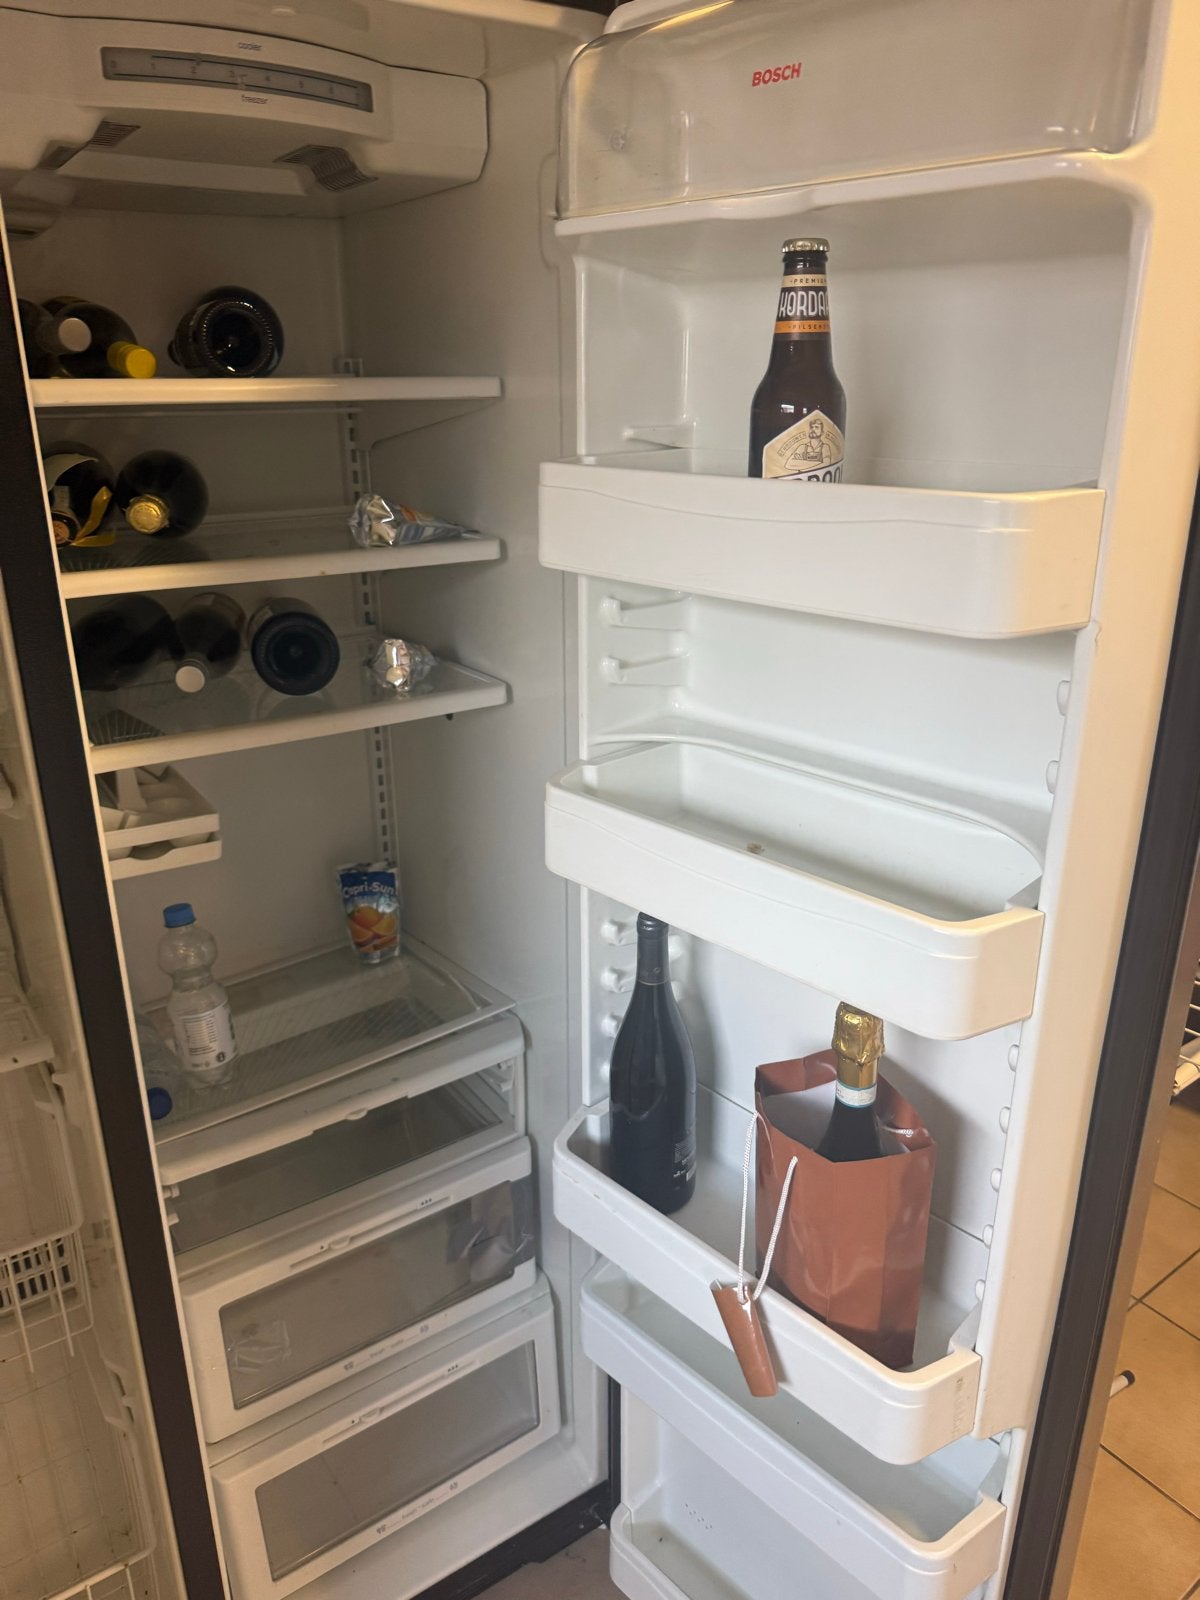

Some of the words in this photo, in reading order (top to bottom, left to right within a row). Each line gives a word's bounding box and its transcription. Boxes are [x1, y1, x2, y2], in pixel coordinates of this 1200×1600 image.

[238, 42, 262, 51] cooler
[752, 62, 802, 87] BOSCH
[241, 94, 269, 105] freezer
[342, 881, 394, 899] Capri-Sun
